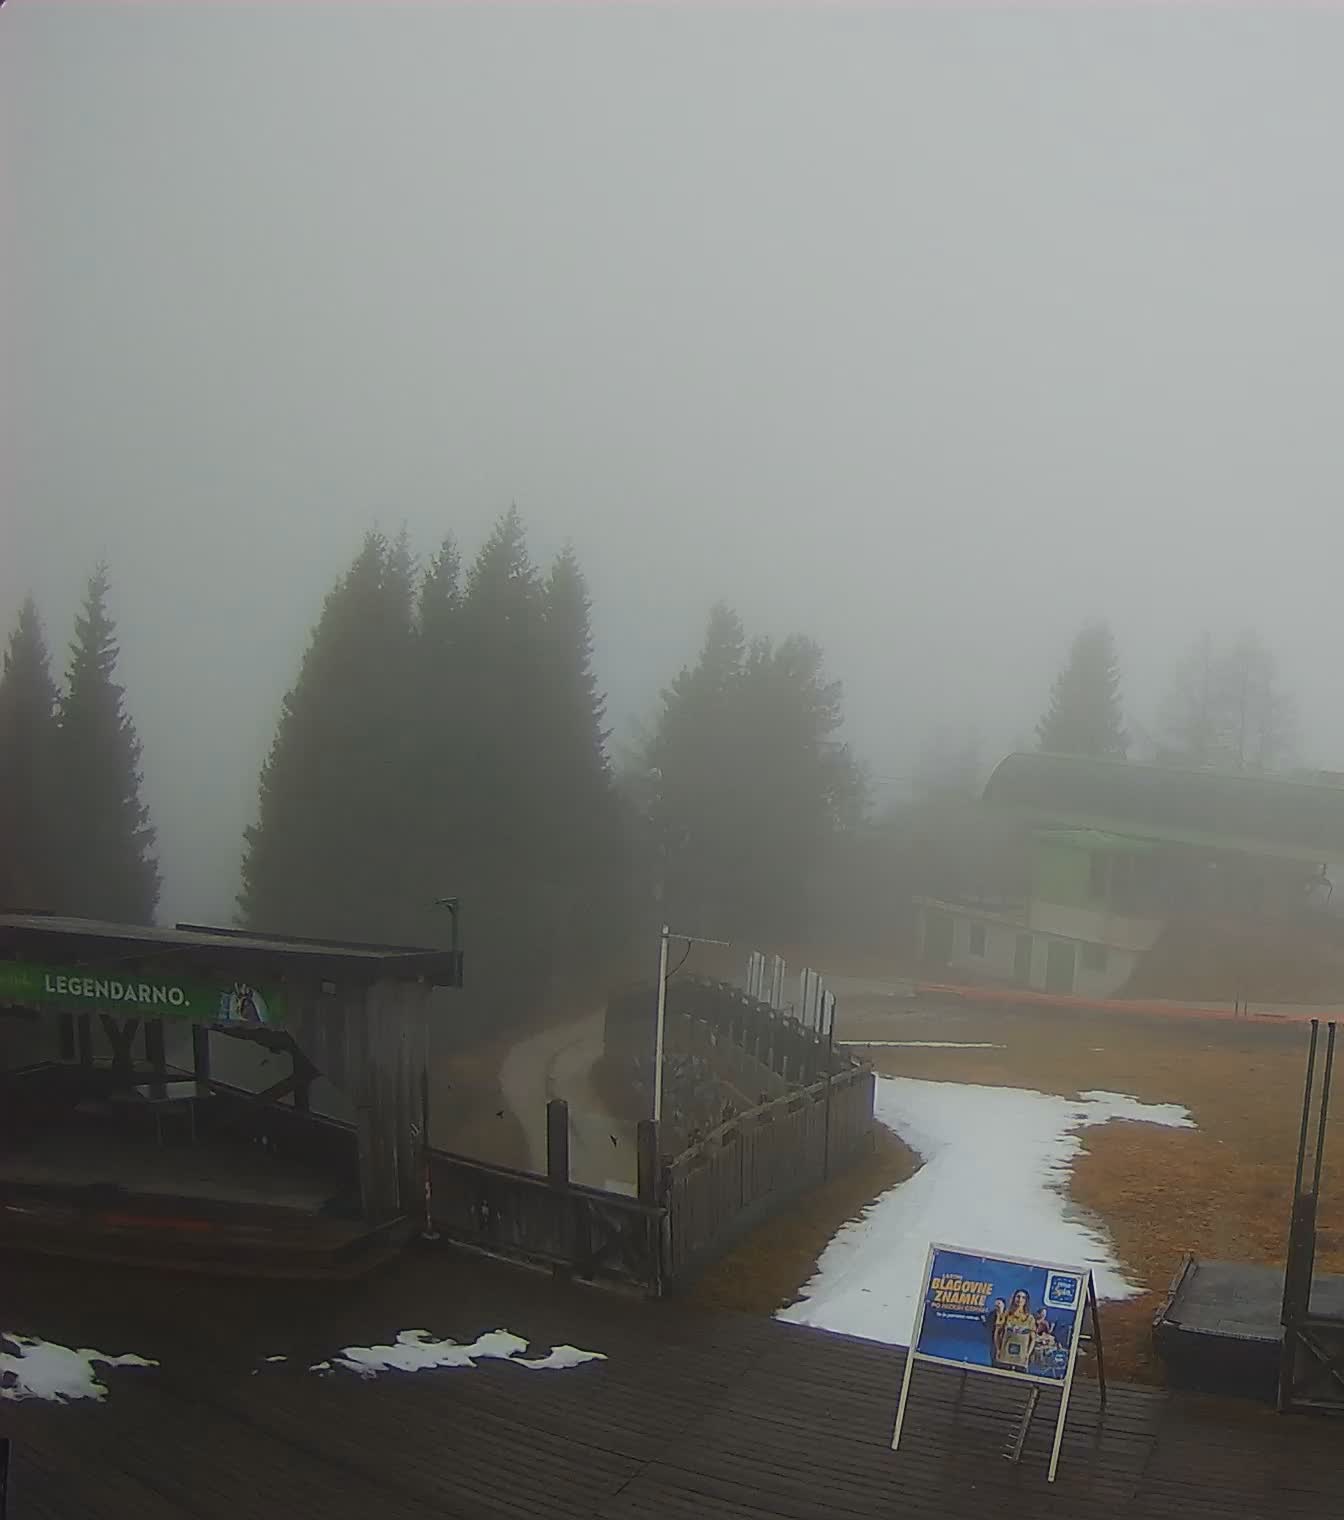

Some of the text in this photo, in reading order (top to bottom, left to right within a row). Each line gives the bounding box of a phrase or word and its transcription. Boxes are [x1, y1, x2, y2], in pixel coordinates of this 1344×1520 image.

[44, 974, 191, 1007] LEGENDARNO.
[931, 1277, 993, 1295] BLAGOVNE
[934, 1290, 987, 1306] ZNAMKE
